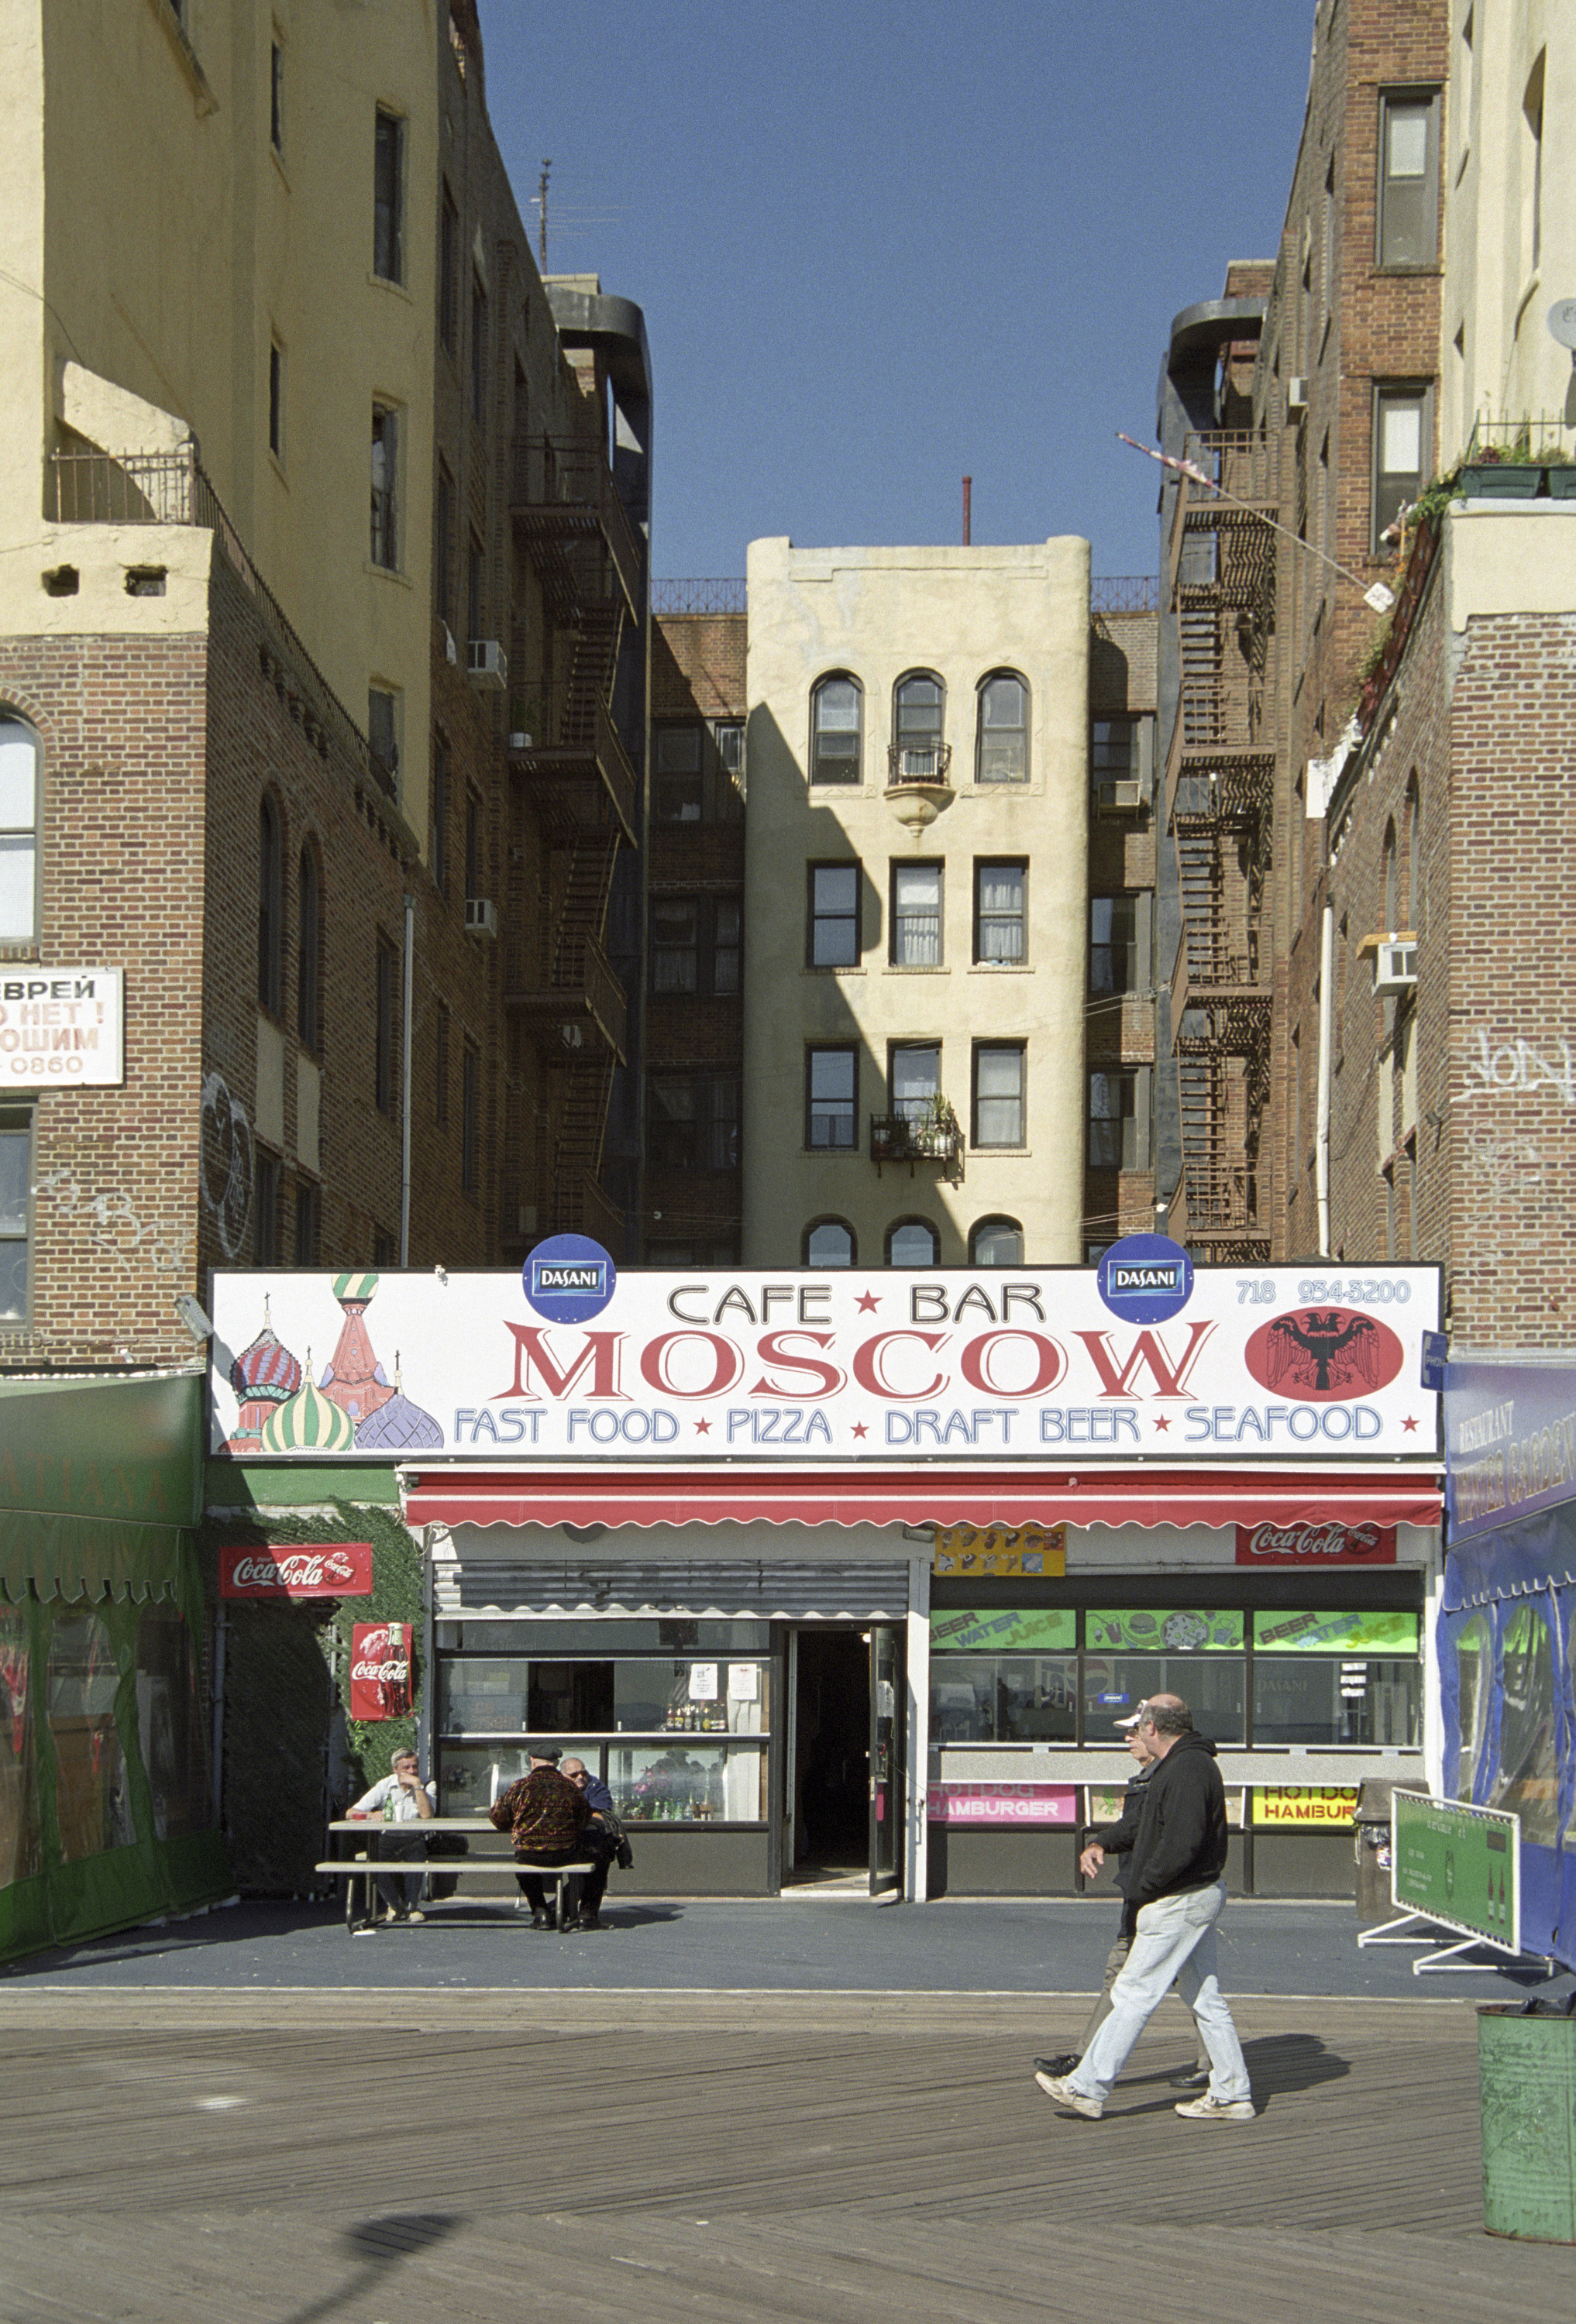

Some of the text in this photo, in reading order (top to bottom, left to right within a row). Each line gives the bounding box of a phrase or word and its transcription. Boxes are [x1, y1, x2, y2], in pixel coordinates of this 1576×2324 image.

[0, 975, 95, 1001] ВРЕЙ
[541, 1268, 599, 1288] DASANI
[1117, 1268, 1177, 1288] DASANI
[1236, 1280, 1412, 1304] 718 934-3200
[667, 1282, 1047, 1325] CAFE BAR
[486, 1318, 1219, 1403] MOSCOW
[454, 1405, 1384, 1446] FAST FOOD PIZZA DRAFT BEER SEAFOOD
[1250, 1524, 1347, 1555] Coca-Cola
[232, 1554, 326, 1587] Coca-Cola
[953, 1611, 1022, 1648] WATER
[1004, 1611, 1064, 1646] JUICE
[1258, 1612, 1320, 1645] BEER
[1293, 1613, 1364, 1649] WATER
[352, 1660, 410, 1681] Coca-Cola
[980, 1783, 1034, 1798] DOG
[927, 1800, 1059, 1816] HAMBURGER
